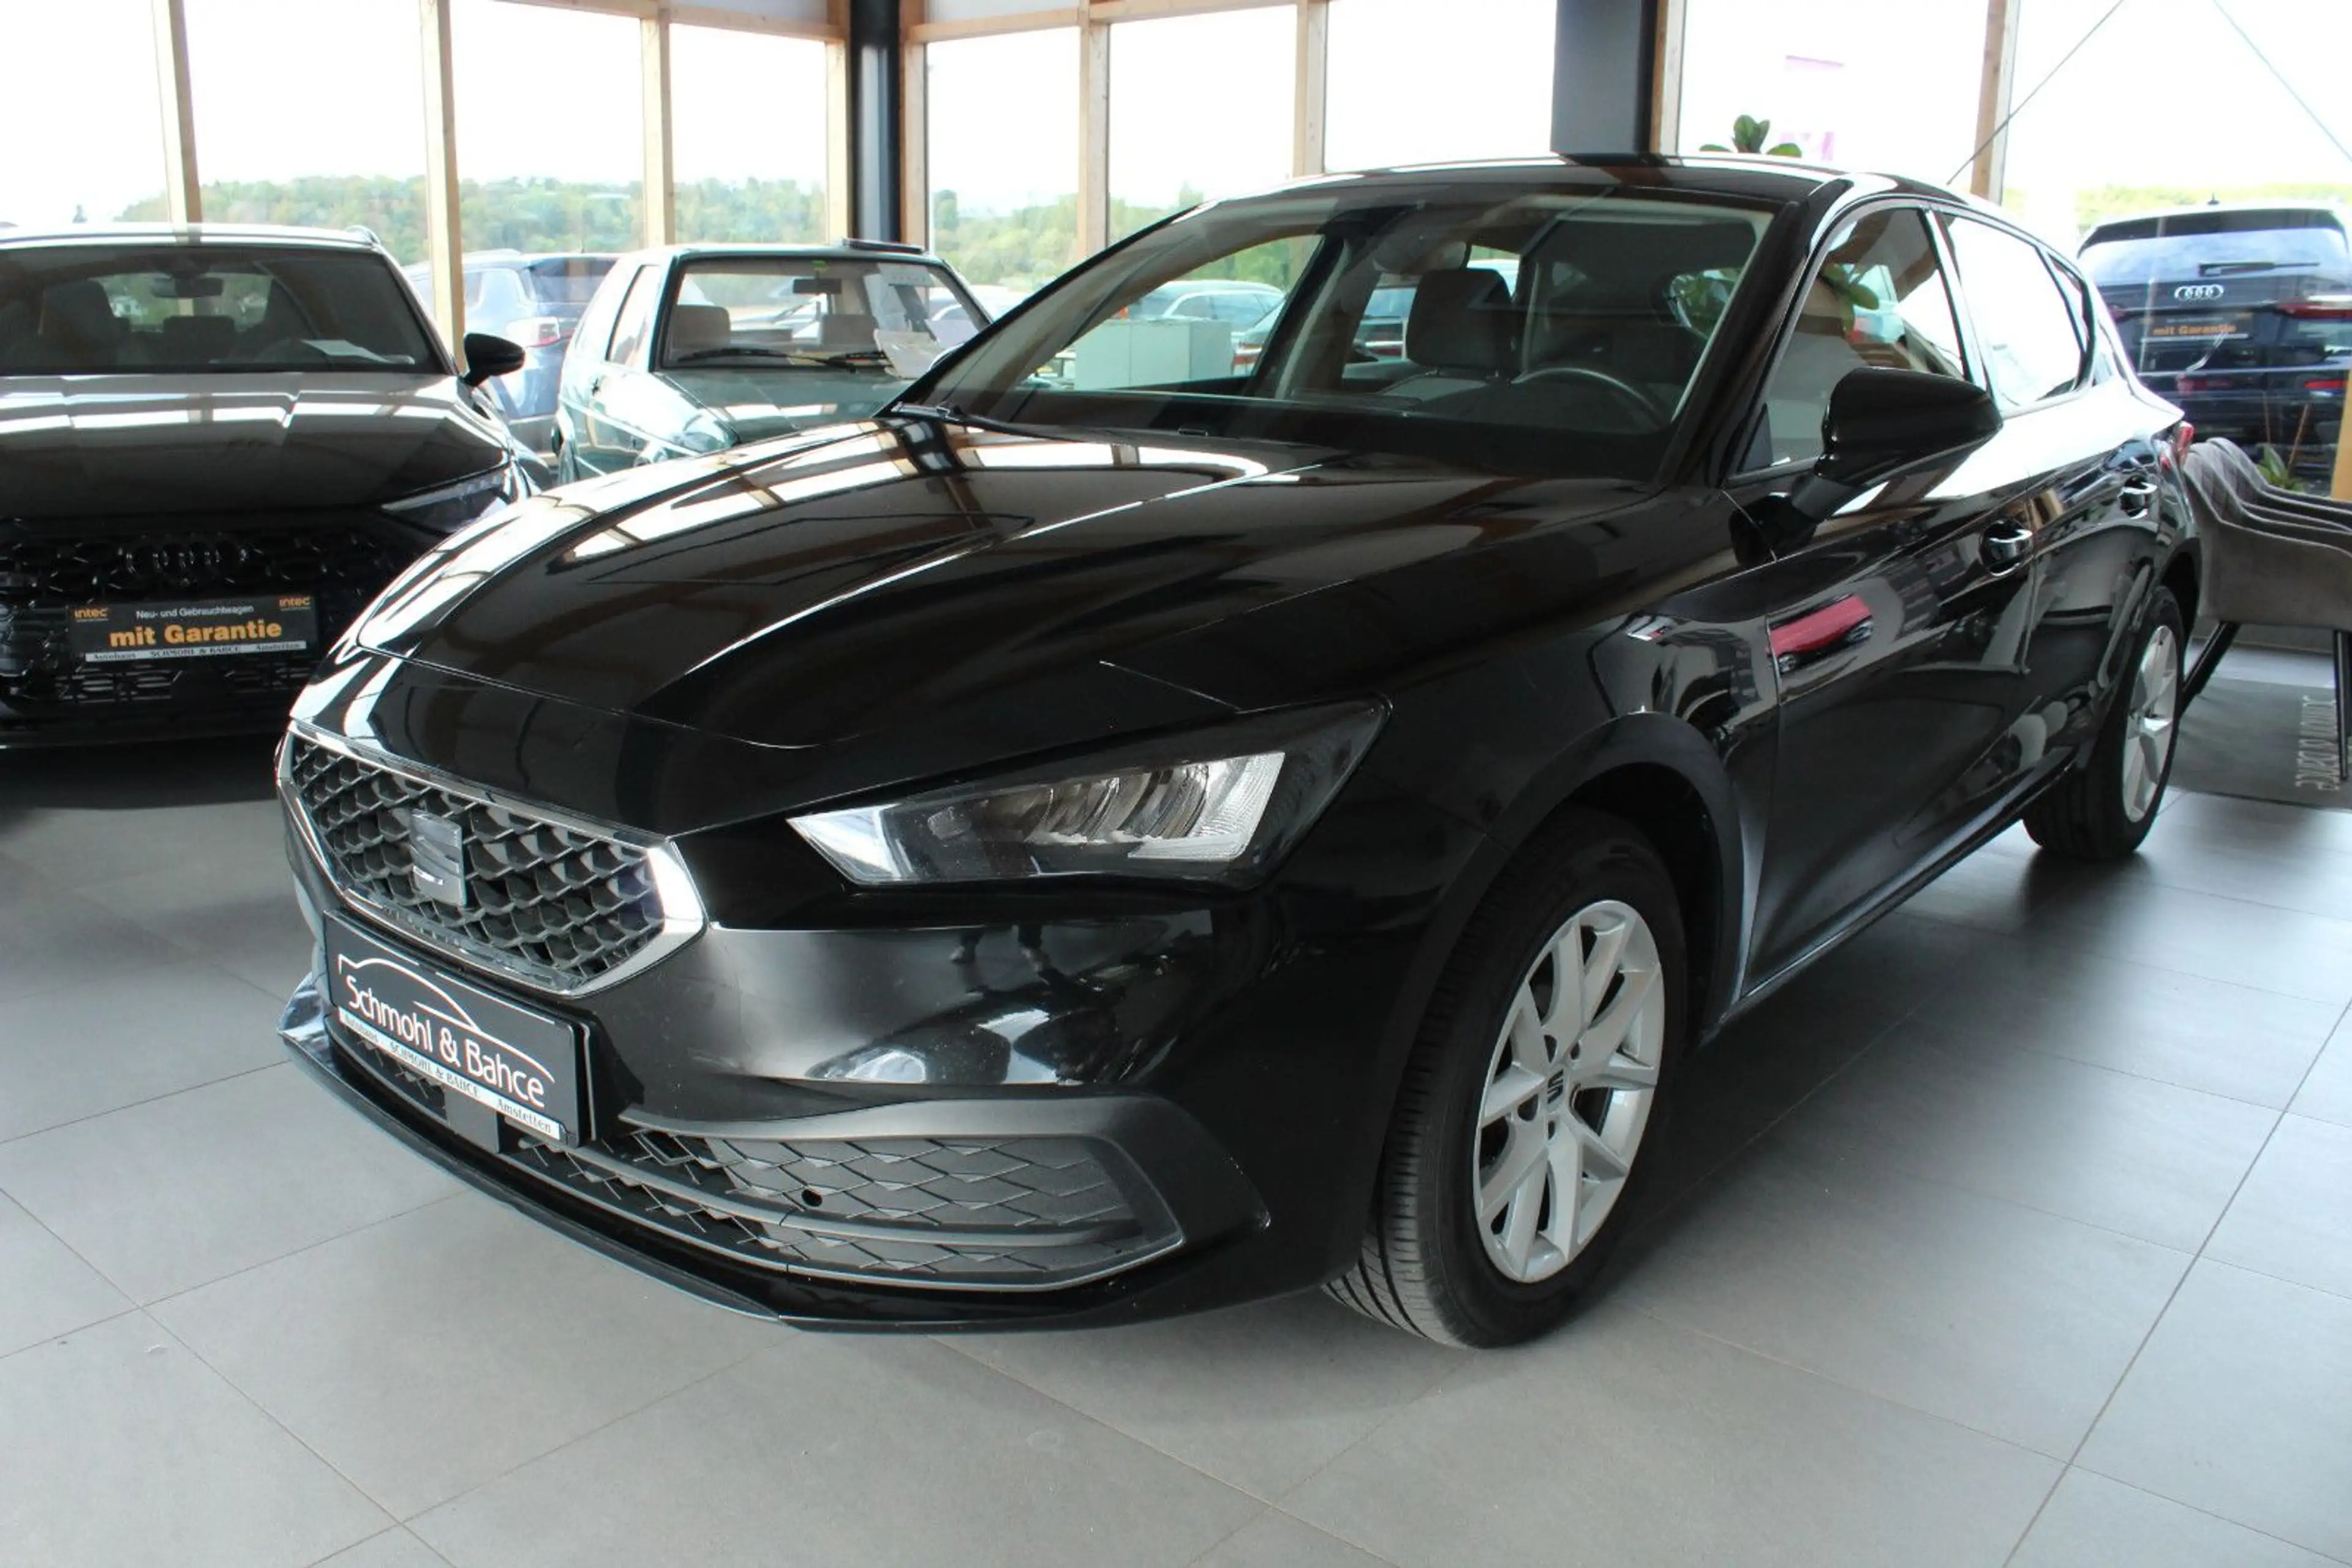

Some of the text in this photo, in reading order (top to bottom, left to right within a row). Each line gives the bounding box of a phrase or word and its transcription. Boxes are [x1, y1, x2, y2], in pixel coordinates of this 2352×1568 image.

[160, 608, 178, 617] und
[110, 618, 282, 647] mit Garantie
[345, 974, 545, 1108] Schmohl & Bahce
[496, 1098, 552, 1135] Amstetten
